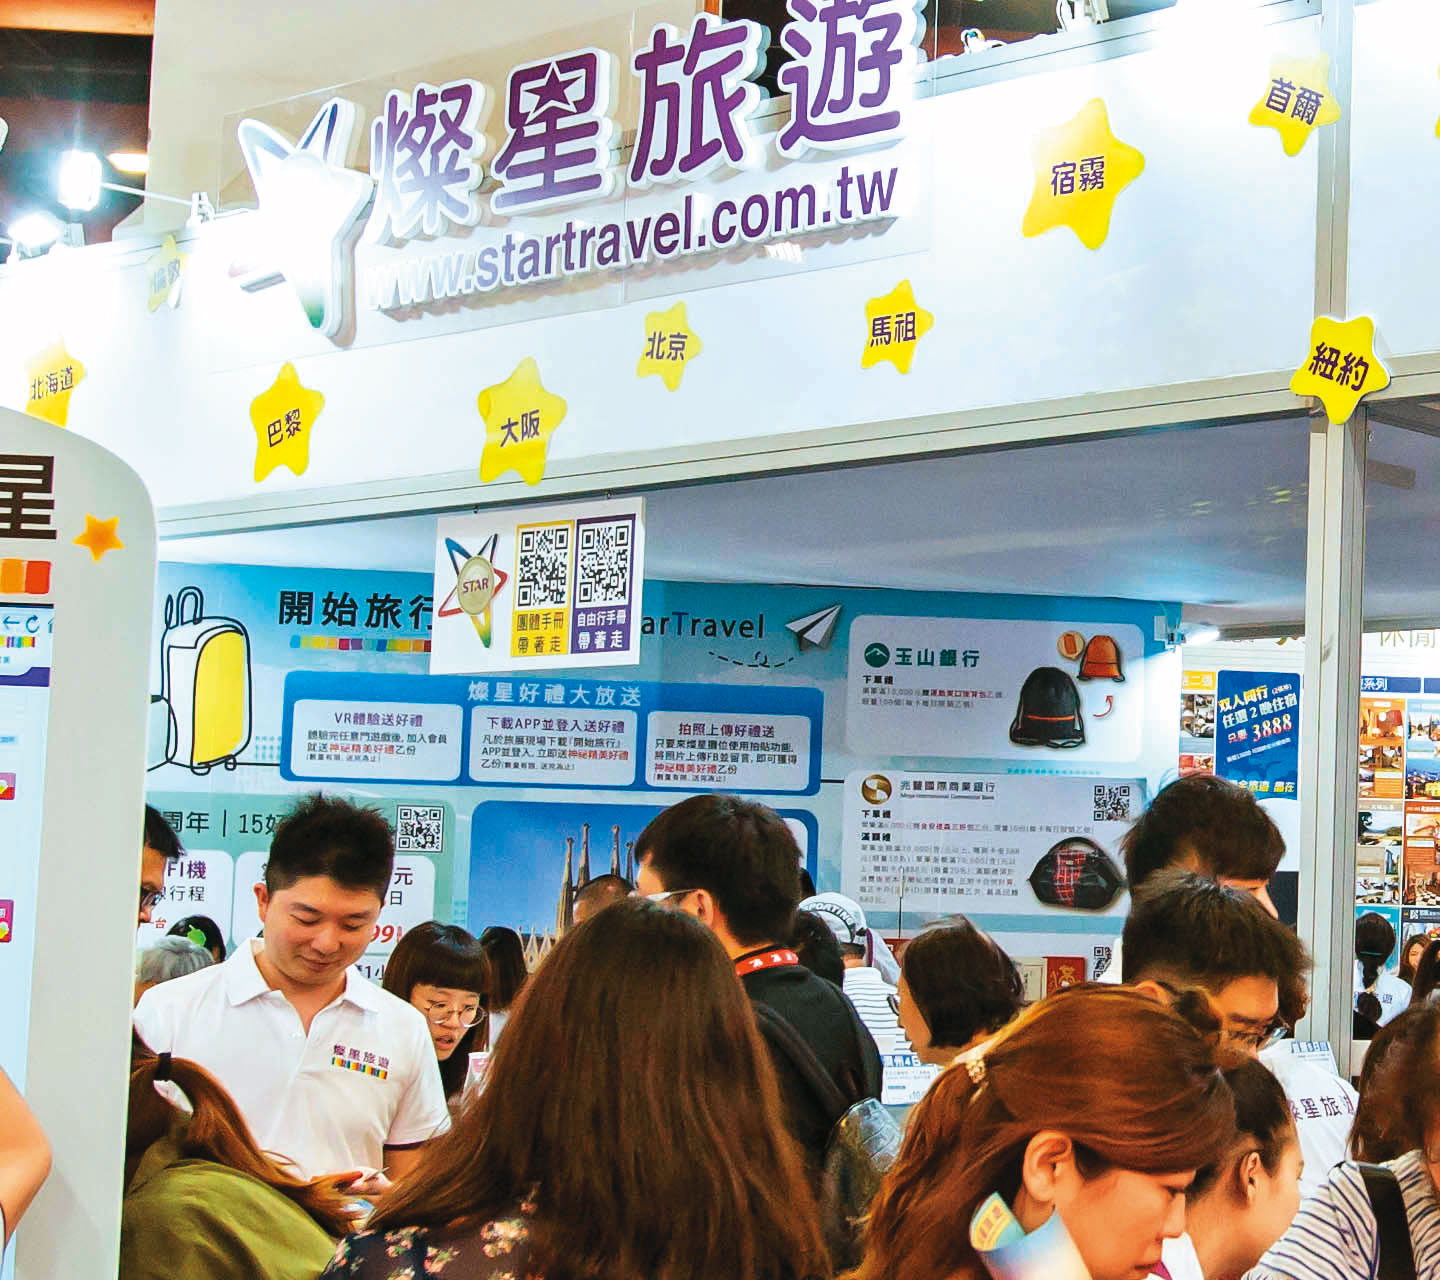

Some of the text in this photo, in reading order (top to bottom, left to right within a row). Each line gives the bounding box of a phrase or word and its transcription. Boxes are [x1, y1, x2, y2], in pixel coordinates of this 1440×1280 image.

[1263, 77, 1322, 127] 首爾
[1049, 155, 1107, 197] 宿霧
[368, 161, 899, 311] www.startravel.com.tw
[868, 311, 918, 348] 馬祖
[644, 332, 688, 365] 北京
[1307, 340, 1372, 393] 紐約
[31, 365, 74, 401] 北海道
[265, 410, 303, 447] 巴黎
[499, 410, 541, 447] 大阪
[461, 575, 490, 594] STAR
[516, 611, 565, 632] 團體手冊
[577, 608, 627, 628] 自由行手冊
[641, 610, 766, 640] arTravel
[516, 633, 563, 656] 帶著走
[578, 628, 624, 651] 帶著走
[894, 646, 981, 668] 玉山銀行
[467, 679, 642, 708] 燦星好禮大放送
[333, 710, 425, 729] VR體驗送好禮
[486, 716, 626, 735] 下載APP並登入送好禮
[678, 722, 776, 739] 拍照上傳好禮送
[1252, 713, 1293, 744] 3888
[167, 860, 207, 880] FI機
[333, 1043, 391, 1069] 燦星旅遊
